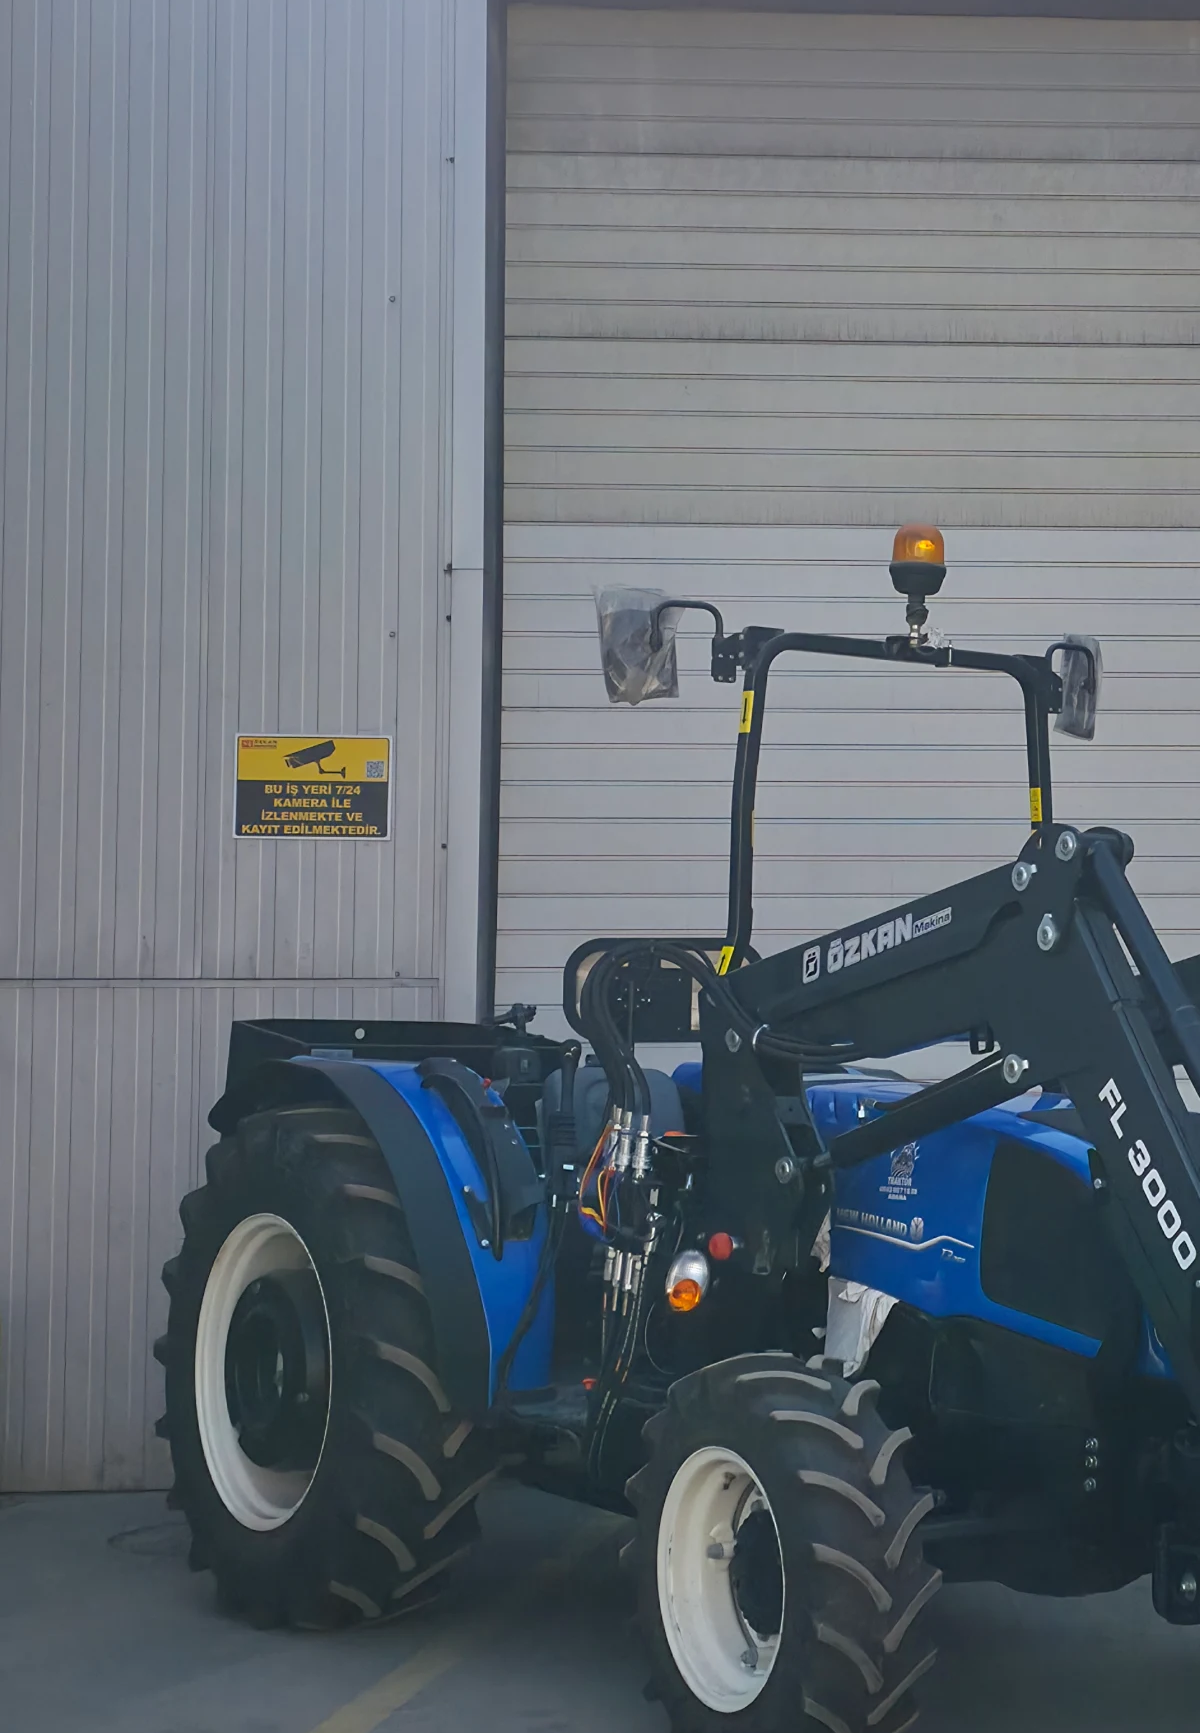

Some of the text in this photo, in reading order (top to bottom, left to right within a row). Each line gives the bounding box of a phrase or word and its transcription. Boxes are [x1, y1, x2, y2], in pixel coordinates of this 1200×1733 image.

[264, 782, 361, 796] BU İŞ YERİ 7/24
[273, 797, 352, 808] KAMERA İLE
[261, 809, 363, 821] İZLENMEKTE VE
[241, 823, 381, 835] KAYIT EDİLMEKTEDİR.
[827, 912, 950, 973] ÖZKAN Makina
[1098, 1077, 1197, 1271] FL 3000
[861, 1212, 908, 1237] HOLLAND
